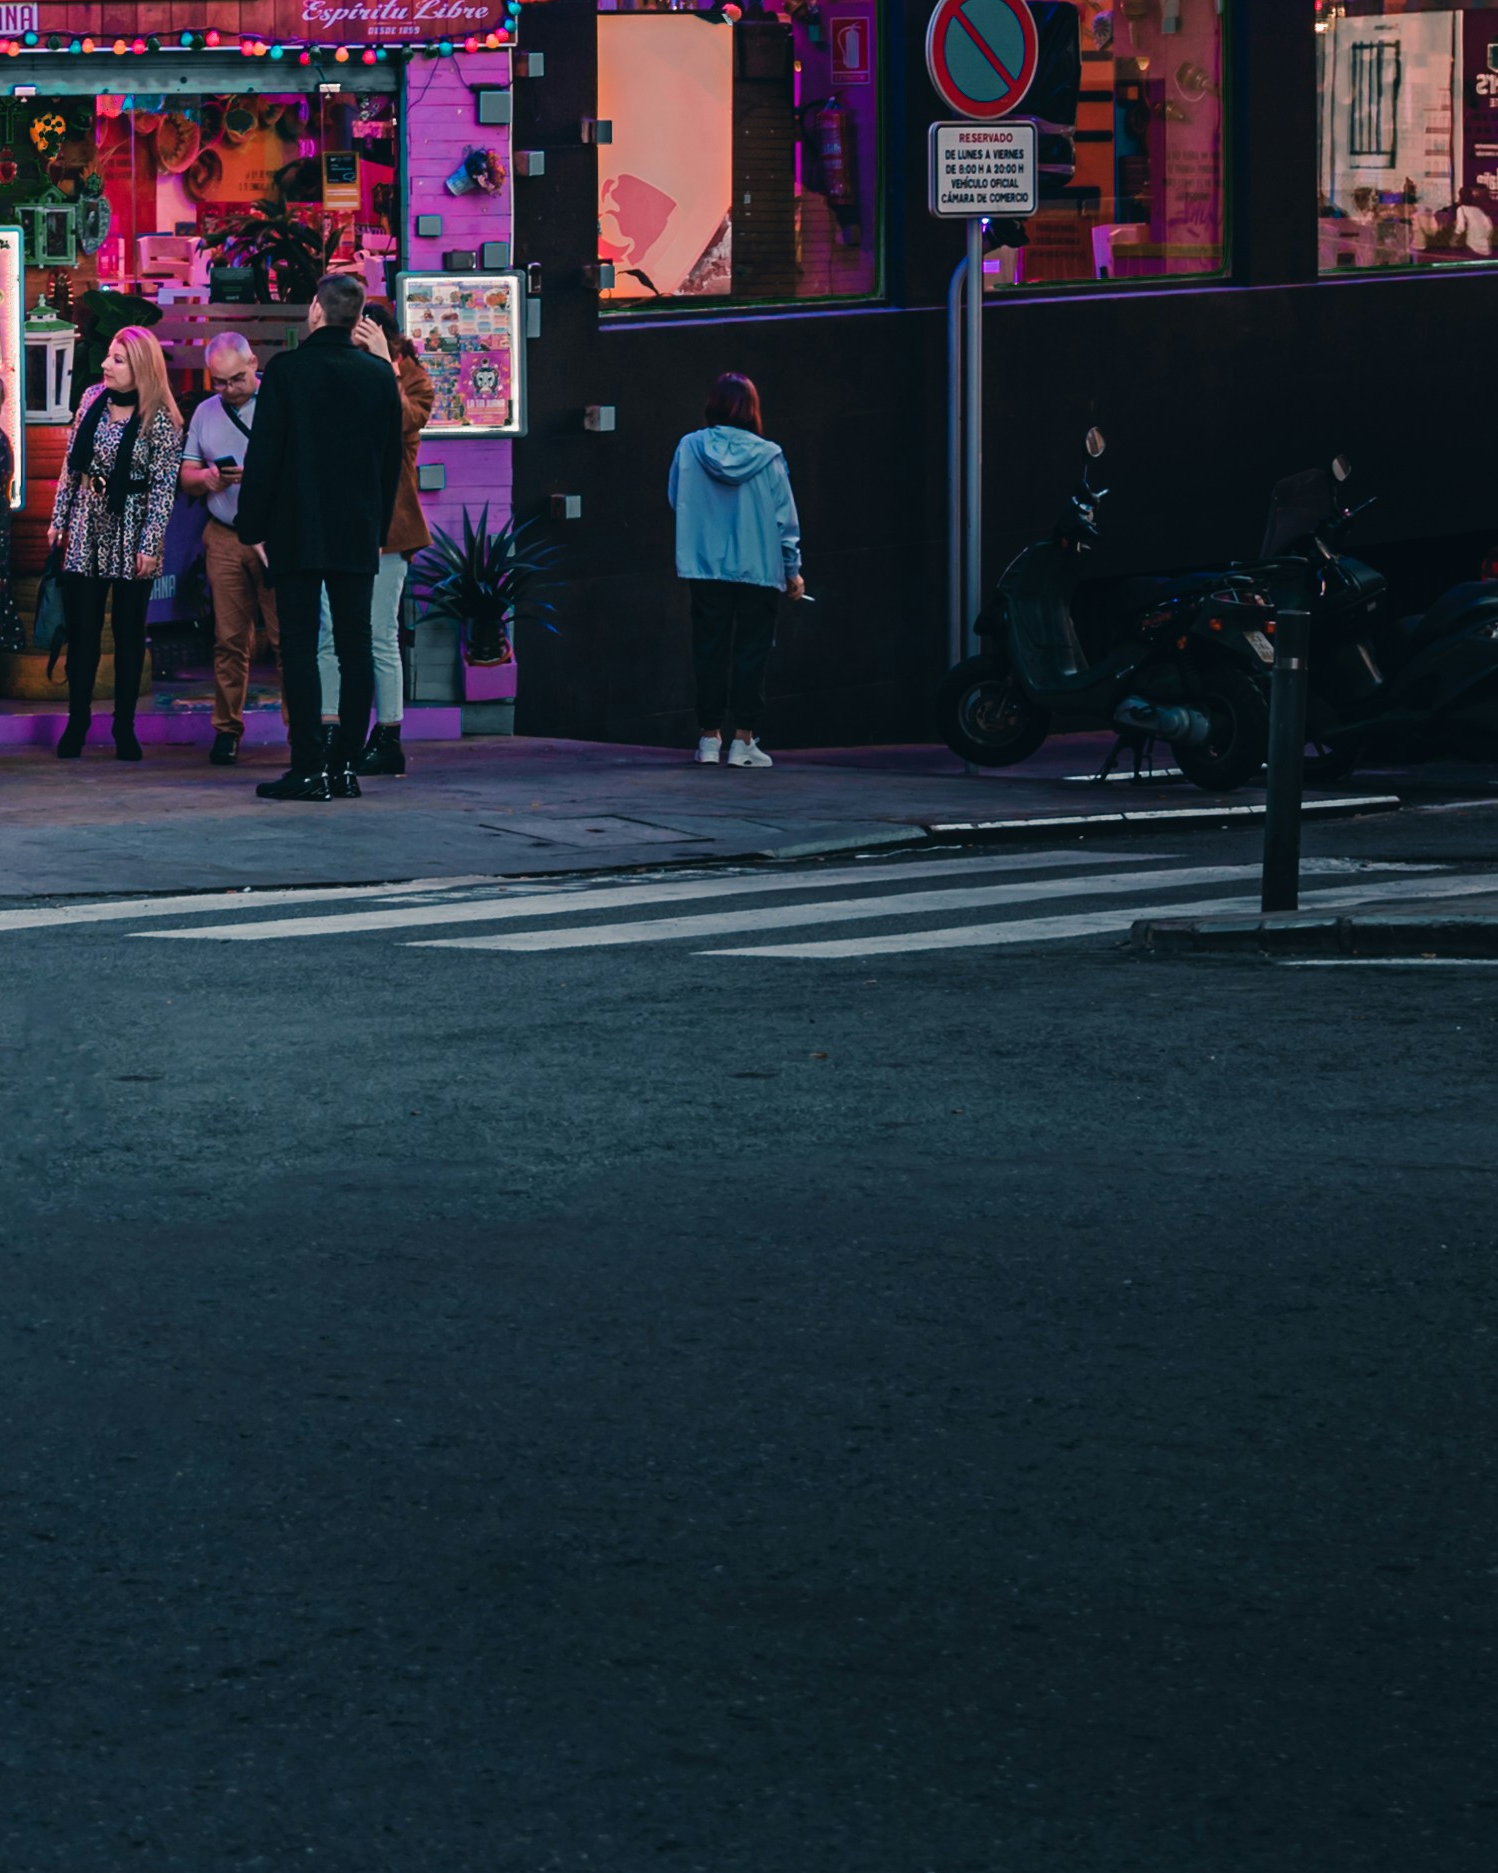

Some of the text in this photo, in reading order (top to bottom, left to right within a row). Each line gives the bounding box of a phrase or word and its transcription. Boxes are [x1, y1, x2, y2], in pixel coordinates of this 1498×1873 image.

[958, 133, 1014, 144] RESERVADO
[944, 149, 1025, 160] DE LUNES A VIERNES
[945, 164, 1024, 175] DE 8:00 H A 20:00 H
[951, 176, 1019, 189] VEHÍCULO OFICIAL
[941, 191, 1029, 204] CÁMARA DE COMERCIO
